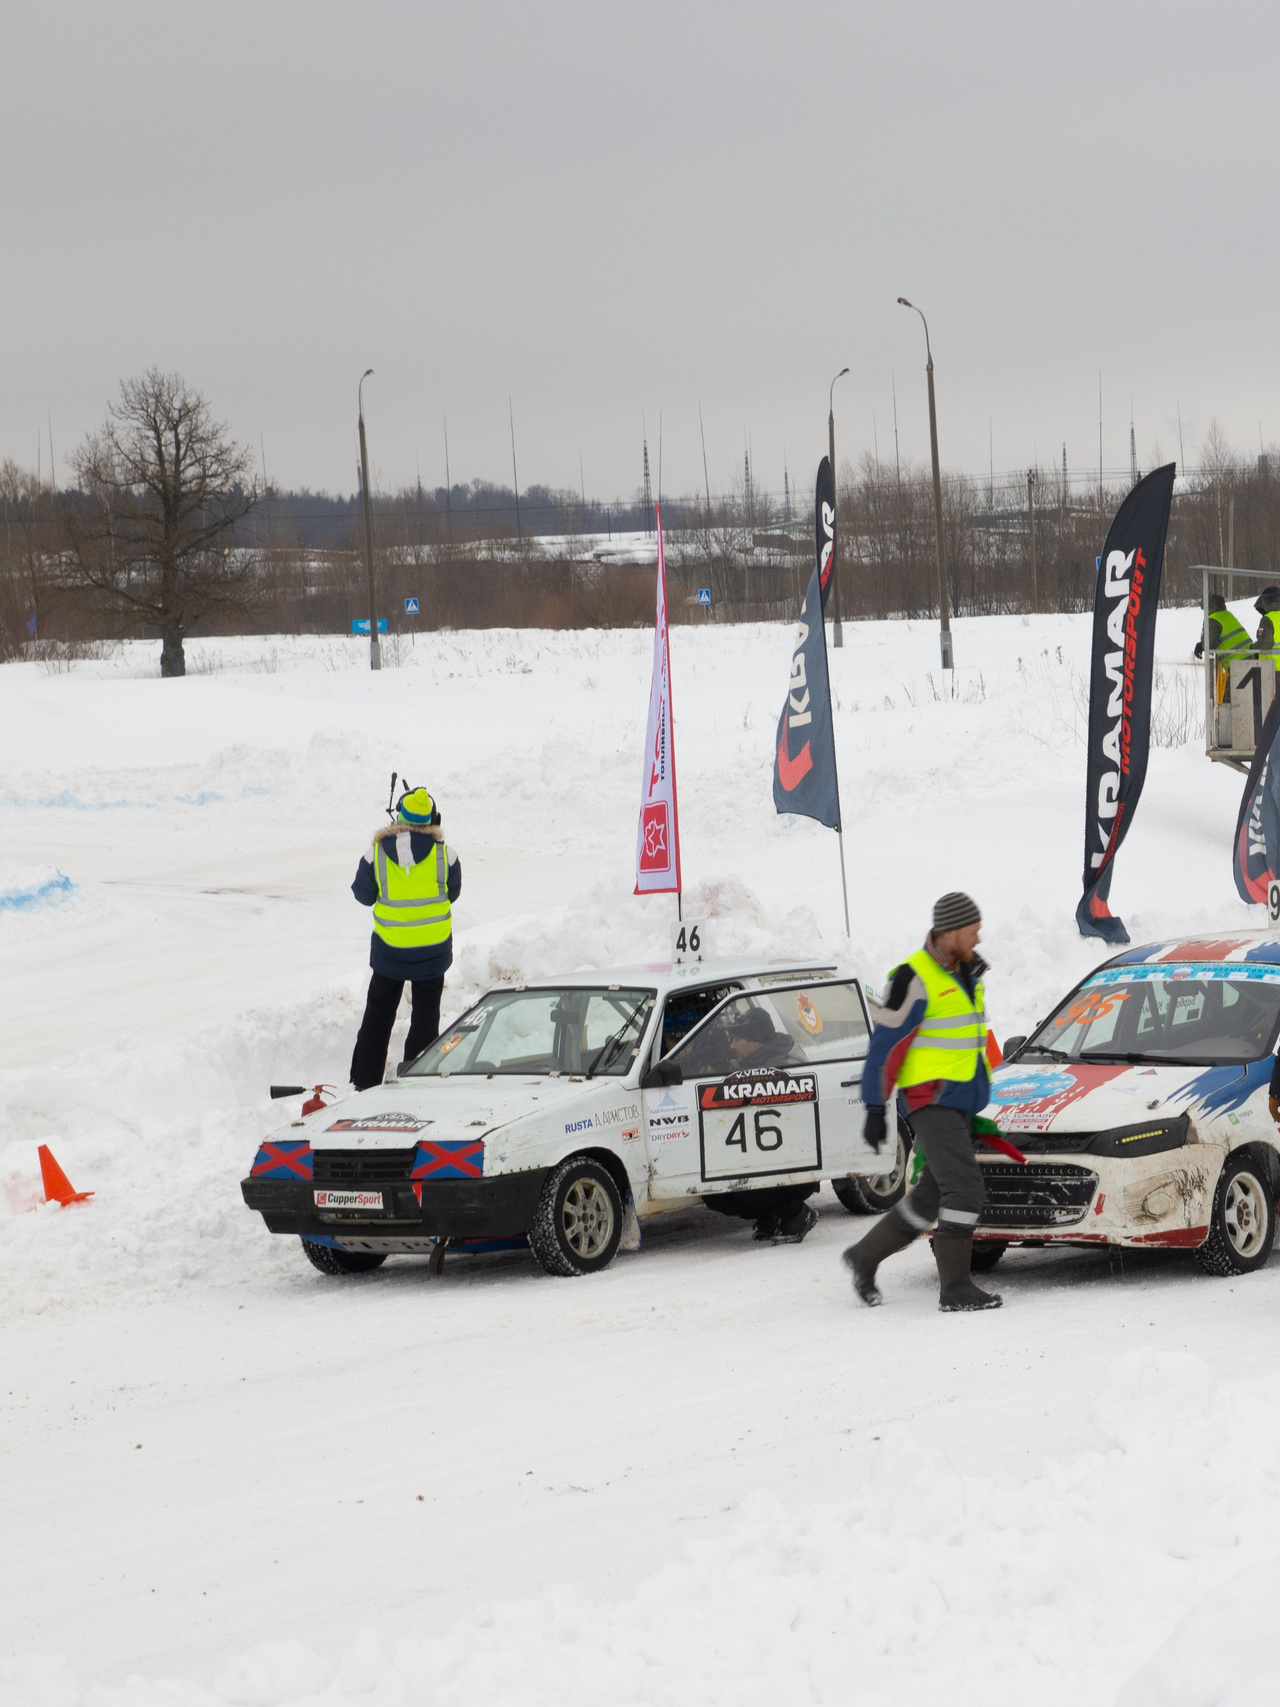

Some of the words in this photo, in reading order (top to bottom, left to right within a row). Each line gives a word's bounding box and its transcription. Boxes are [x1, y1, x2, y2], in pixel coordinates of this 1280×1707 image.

[1121, 547, 1146, 775] MOTORSPORT
[1091, 548, 1136, 869] KRAMAR
[1236, 667, 1263, 745] 1
[676, 925, 701, 952] 46
[463, 1005, 494, 1026] 46
[1053, 993, 1131, 1026] 95
[723, 1078, 814, 1100] KRAMAR
[750, 1092, 815, 1105] MOTORSPORT
[848, 1098, 865, 1106] DRY
[565, 1118, 593, 1134] RUSTA
[649, 1115, 690, 1127] NWB
[725, 1109, 783, 1153] 46
[651, 1132, 681, 1142] DRYDRY
[327, 1193, 381, 1205] CupperSport
